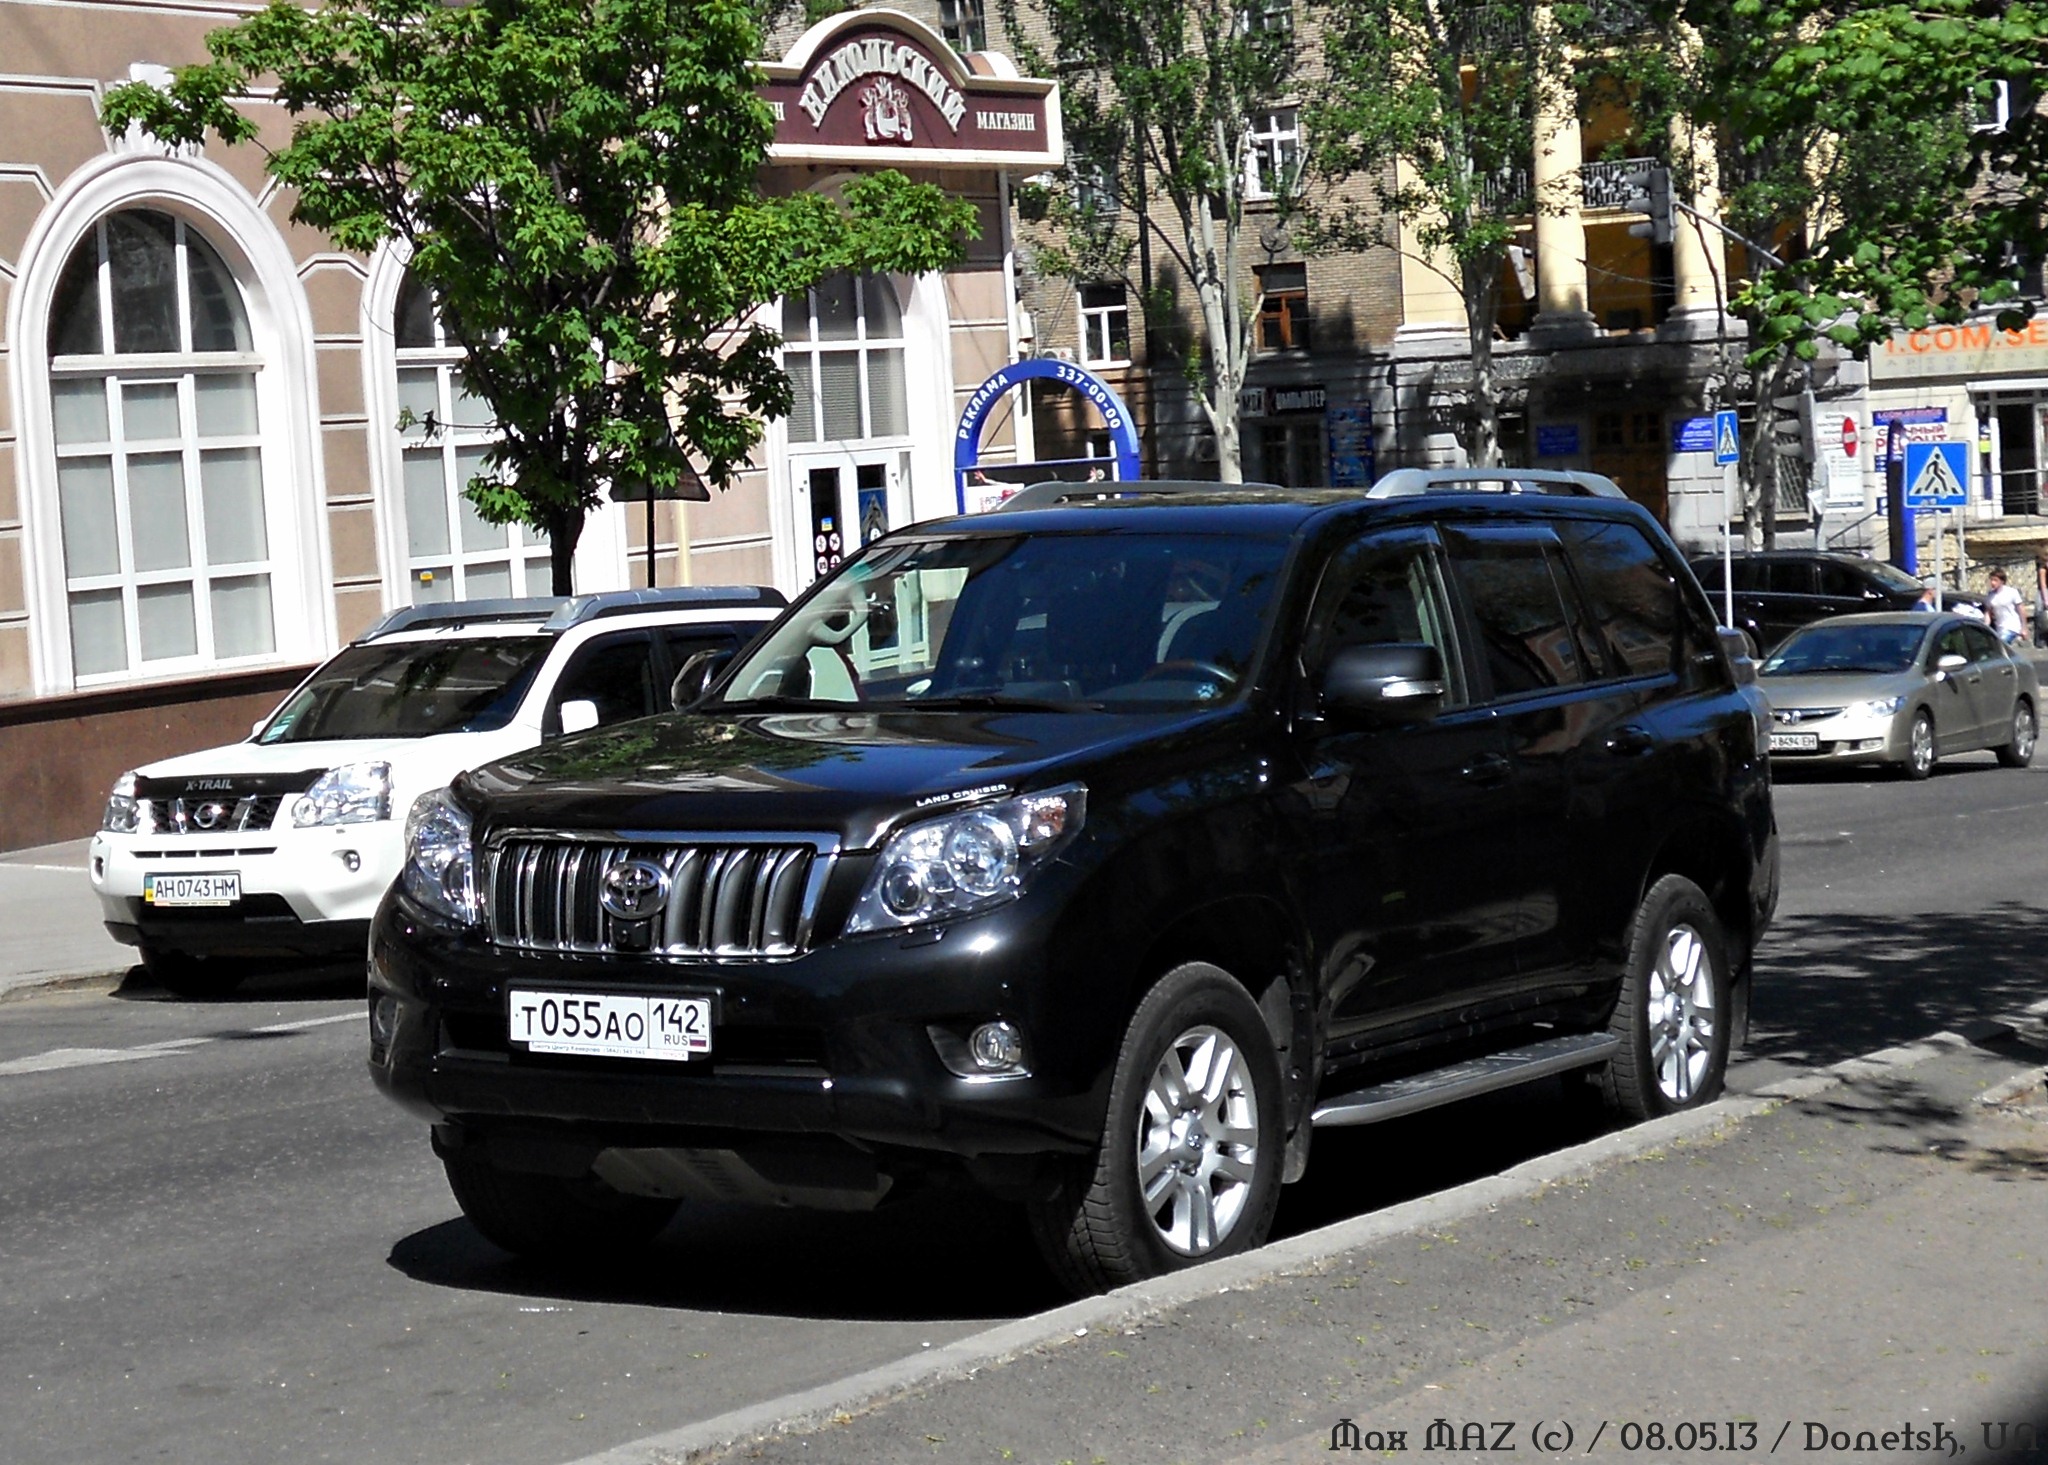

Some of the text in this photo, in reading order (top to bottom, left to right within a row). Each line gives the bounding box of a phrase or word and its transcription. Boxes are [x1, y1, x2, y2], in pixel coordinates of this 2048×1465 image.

[798, 38, 967, 134] НИКОЛЬСКИЙ
[976, 111, 1035, 132] МАГАЗИН
[958, 373, 1009, 440] РЕКЛАМА
[1056, 365, 1122, 430] 337-00-00
[185, 778, 233, 791] X-TRAIL
[916, 783, 1008, 808] LAND CRUISER
[652, 1002, 700, 1034] 142
[663, 1034, 689, 1047] RUS
